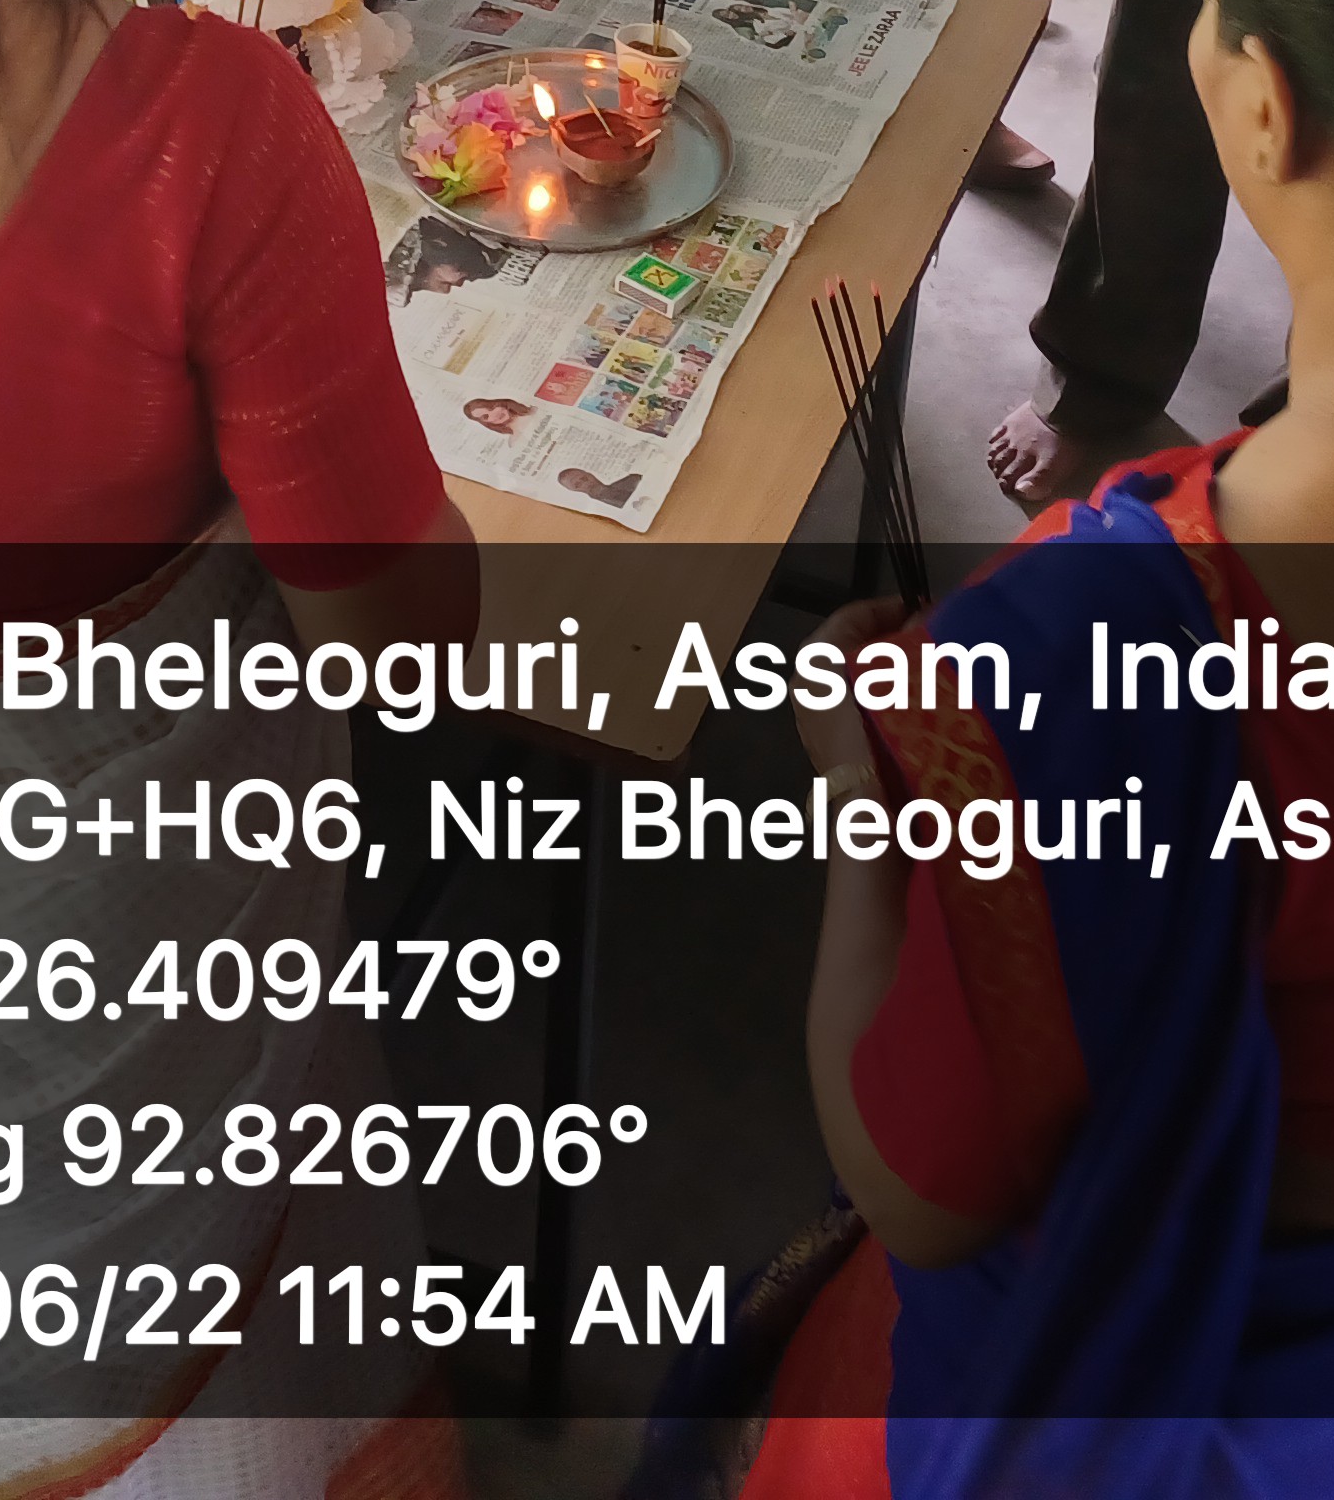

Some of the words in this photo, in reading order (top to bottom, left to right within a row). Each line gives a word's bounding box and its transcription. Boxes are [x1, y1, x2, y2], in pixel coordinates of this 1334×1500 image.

[867, 10, 902, 46] ZARAA
[858, 43, 879, 58] LE
[848, 56, 871, 77] JEE
